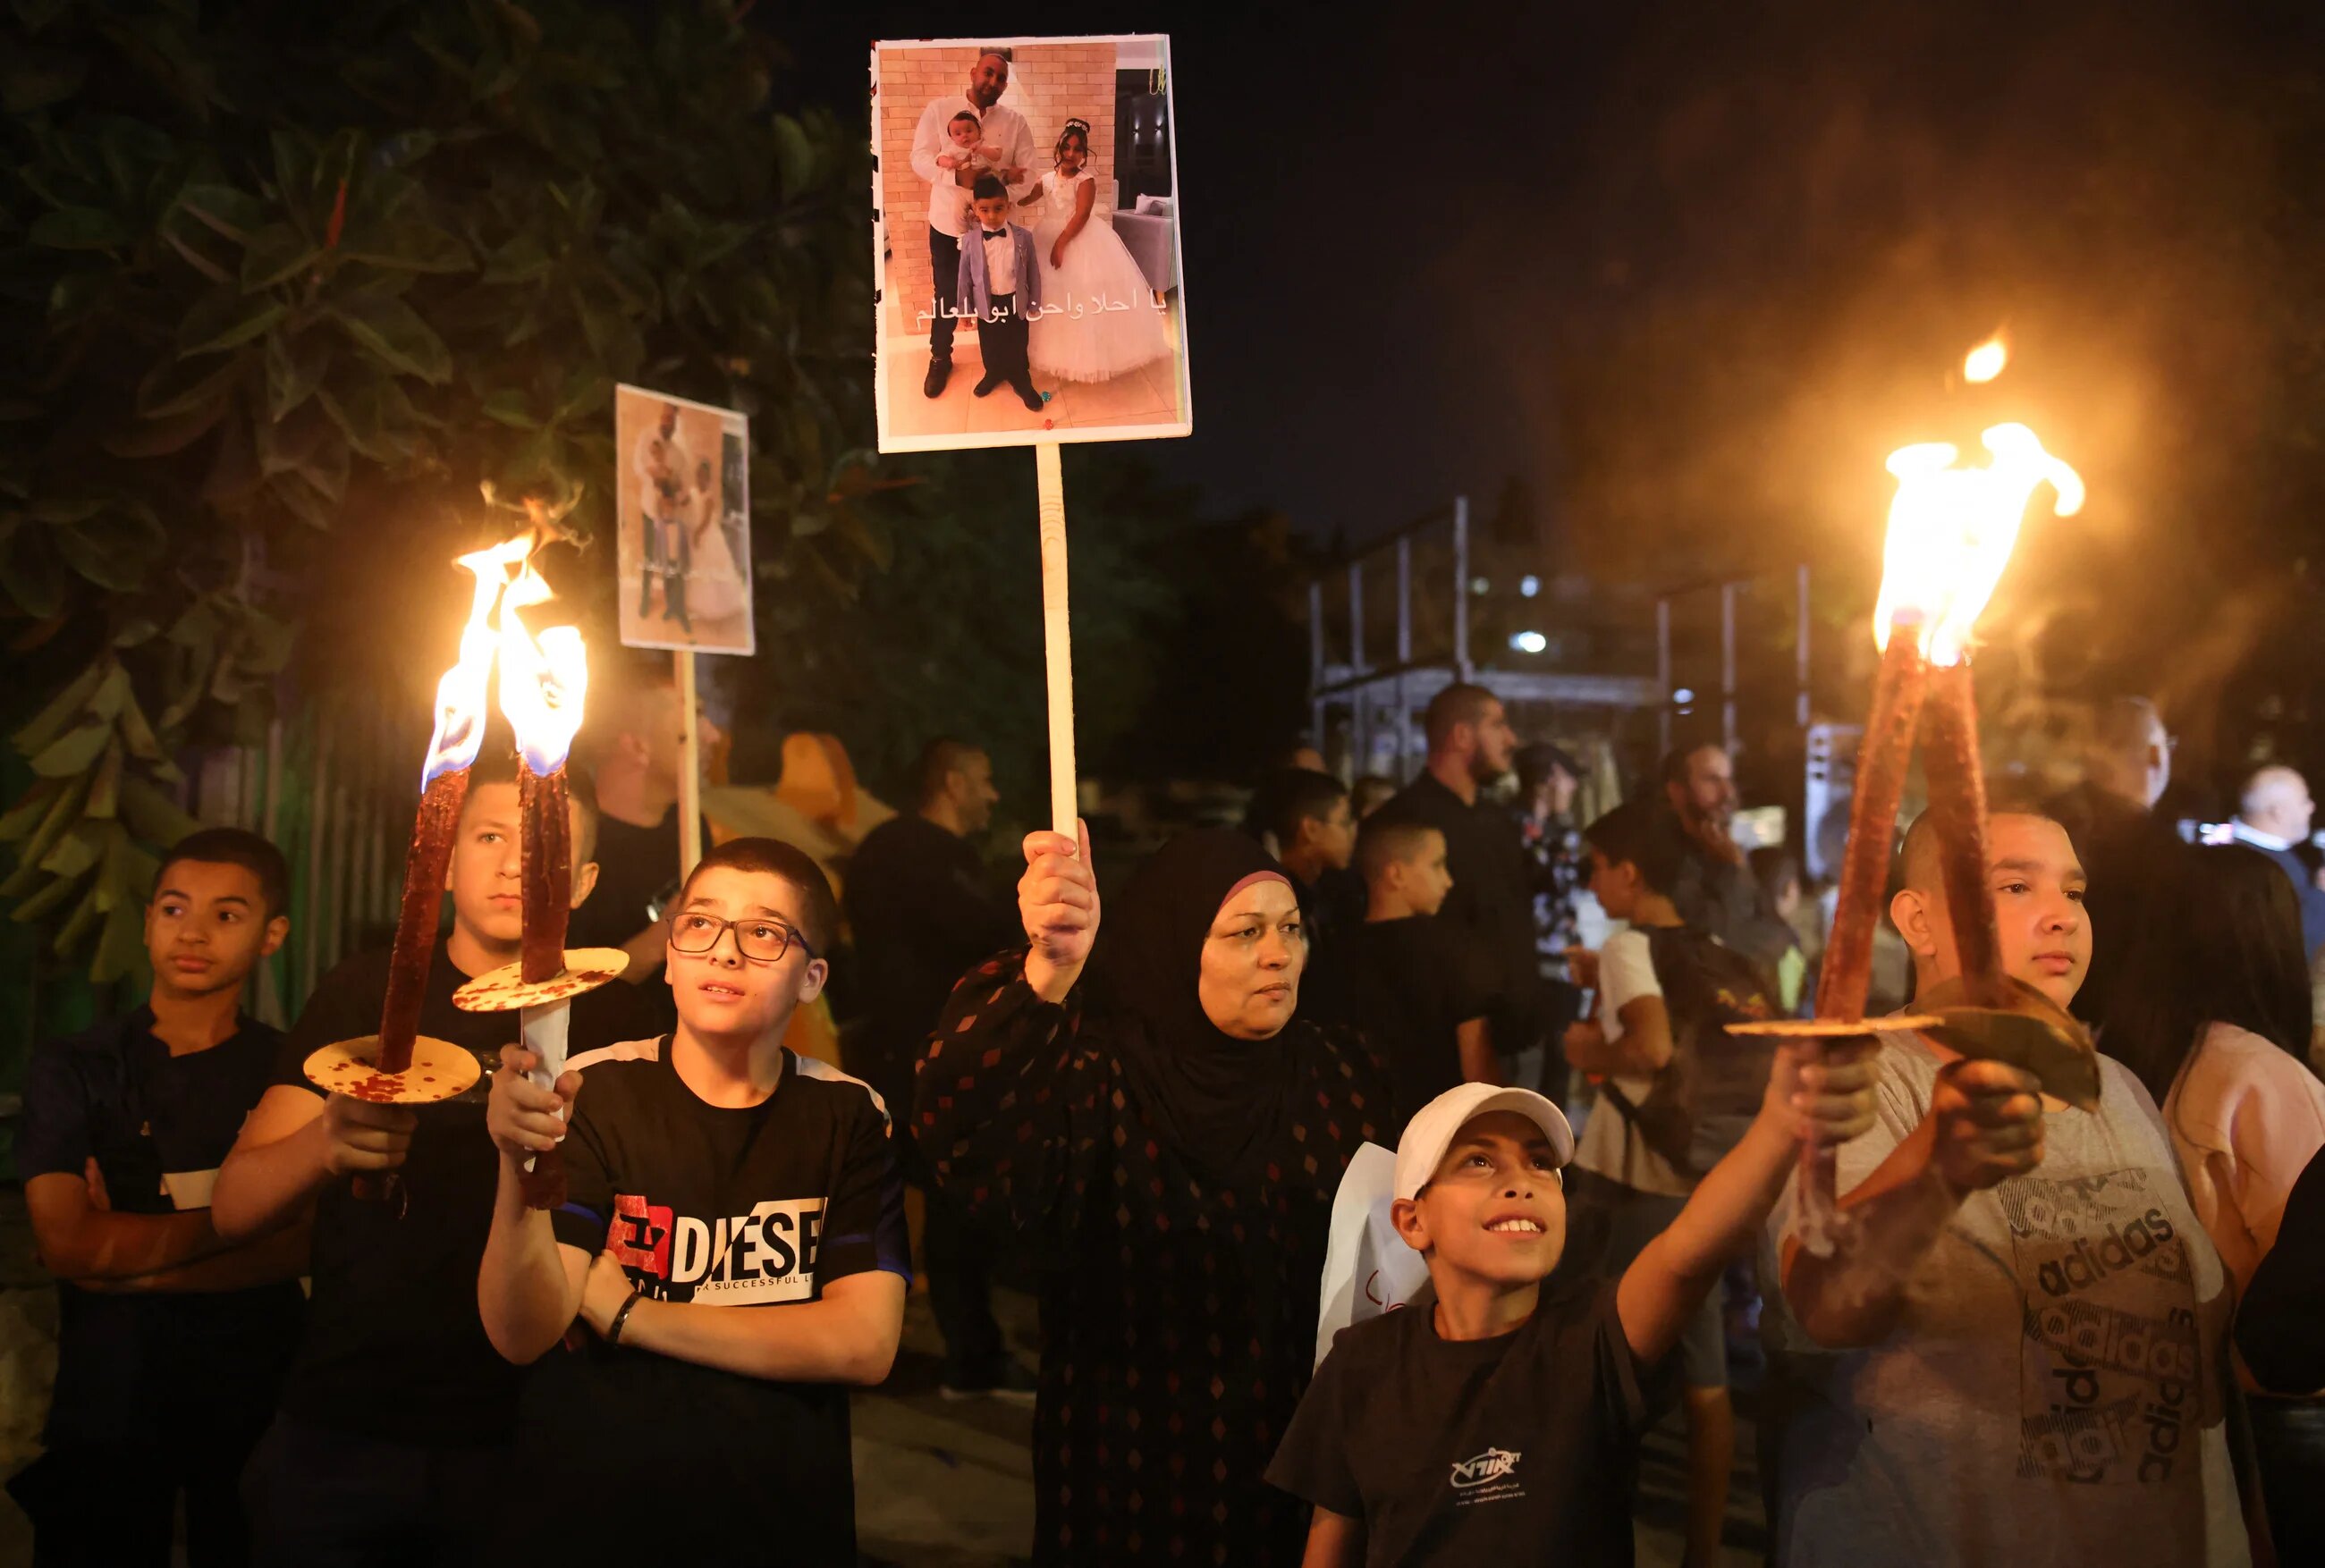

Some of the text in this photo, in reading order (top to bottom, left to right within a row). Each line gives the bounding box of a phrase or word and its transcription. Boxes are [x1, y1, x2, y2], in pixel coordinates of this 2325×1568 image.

[916, 287, 1167, 331] يا احلا واحن ابو بلعالم
[2039, 1209, 2174, 1297] adidas
[714, 1276, 799, 1291] SUCCESSFUL
